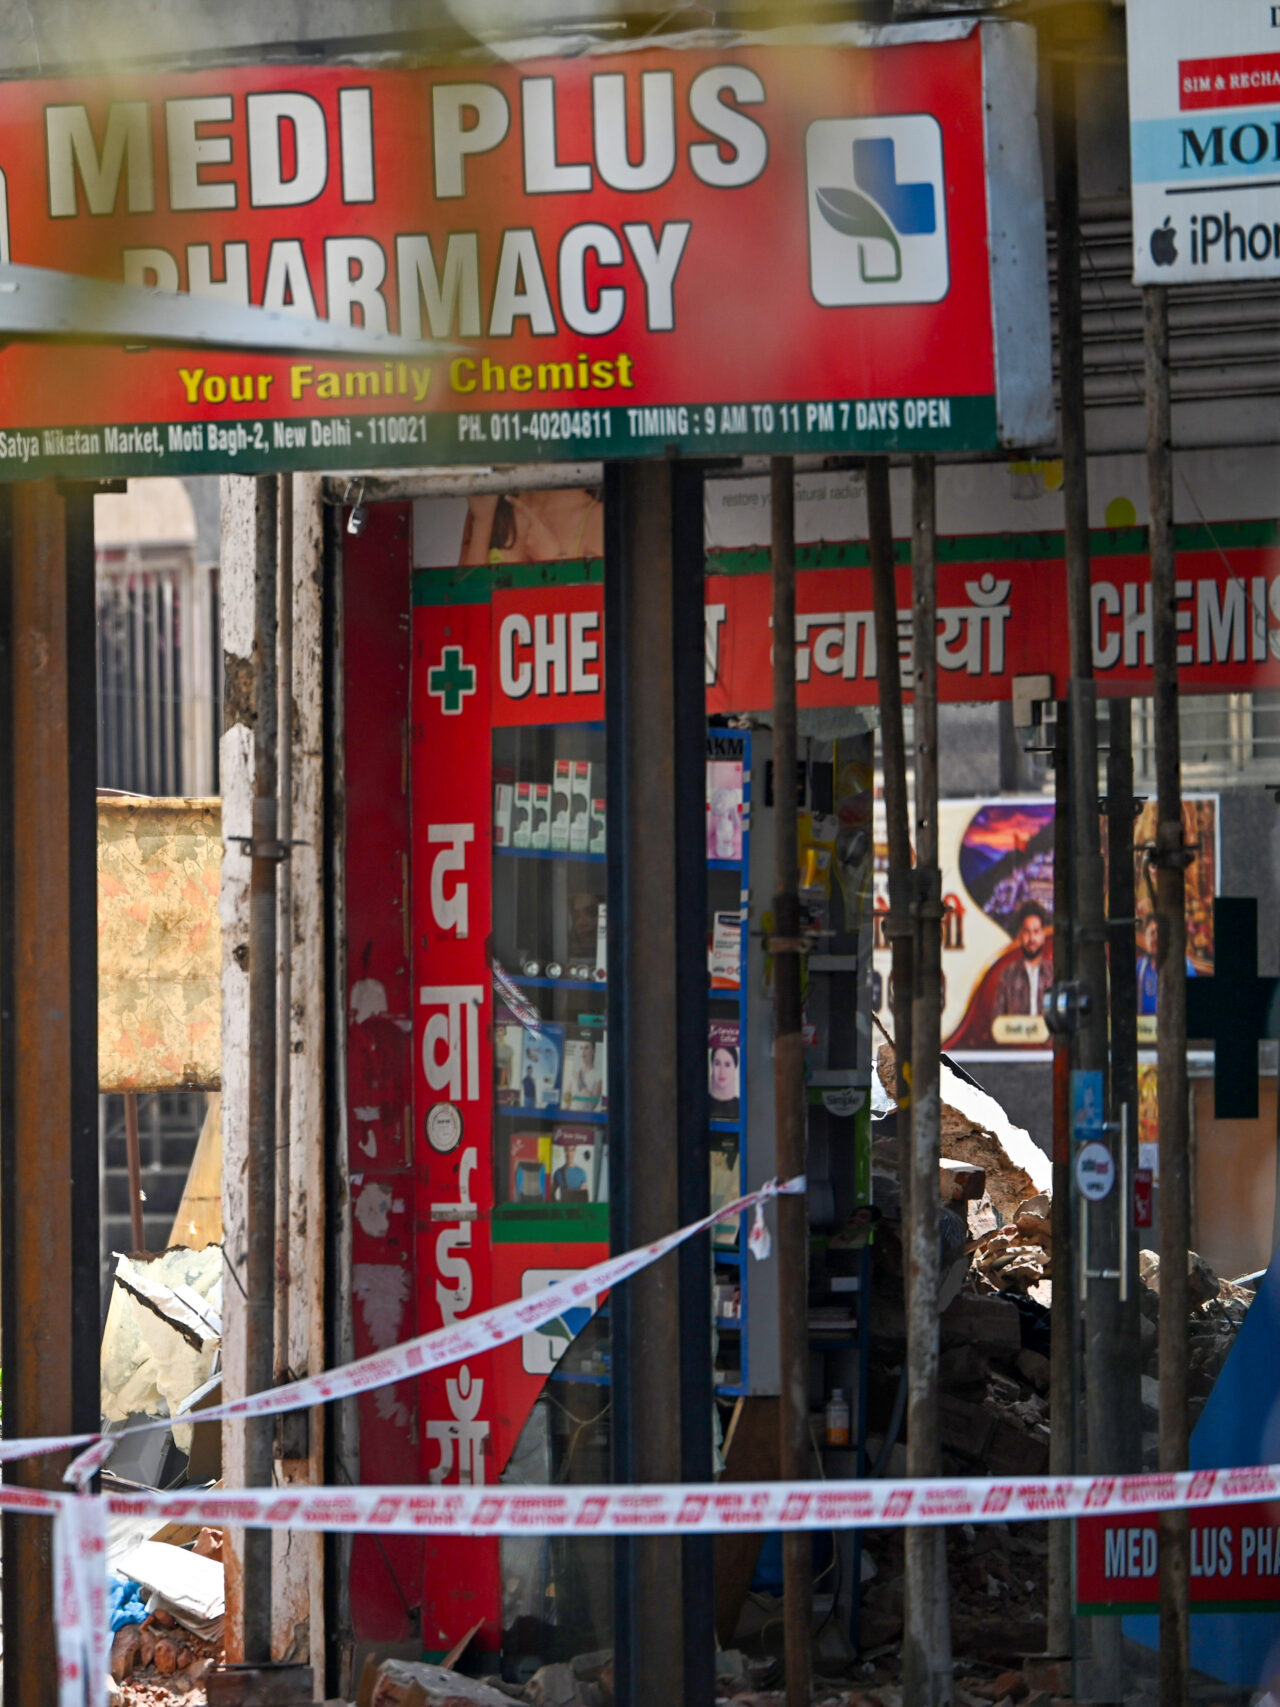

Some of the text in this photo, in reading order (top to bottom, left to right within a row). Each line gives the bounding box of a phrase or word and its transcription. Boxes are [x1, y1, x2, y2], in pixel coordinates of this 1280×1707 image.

[1183, 76, 1211, 94] SIM
[1215, 74, 1226, 91] &
[45, 64, 769, 218] MEDI PLUS
[122, 221, 692, 346] PHARMACY
[178, 352, 635, 403] Your Family Chemist
[104, 425, 165, 457] Market,
[169, 424, 203, 452] Moti
[207, 421, 269, 456] Bagh-2,
[273, 420, 306, 448] New
[311, 417, 351, 447] Delhi
[368, 415, 428, 444] 110021
[459, 410, 611, 441] PH. 011-40204811
[627, 408, 688, 437] TIMING
[704, 406, 715, 434] 9
[720, 404, 748, 434] AM
[751, 404, 774, 433] TO
[780, 403, 800, 433] 11
[806, 402, 834, 432] PM
[839, 402, 850, 431] 7
[856, 400, 899, 430] DAYS
[904, 398, 951, 428] OPEN
[1105, 1527, 1159, 1578] MED
[1190, 1526, 1233, 1577] LUS
